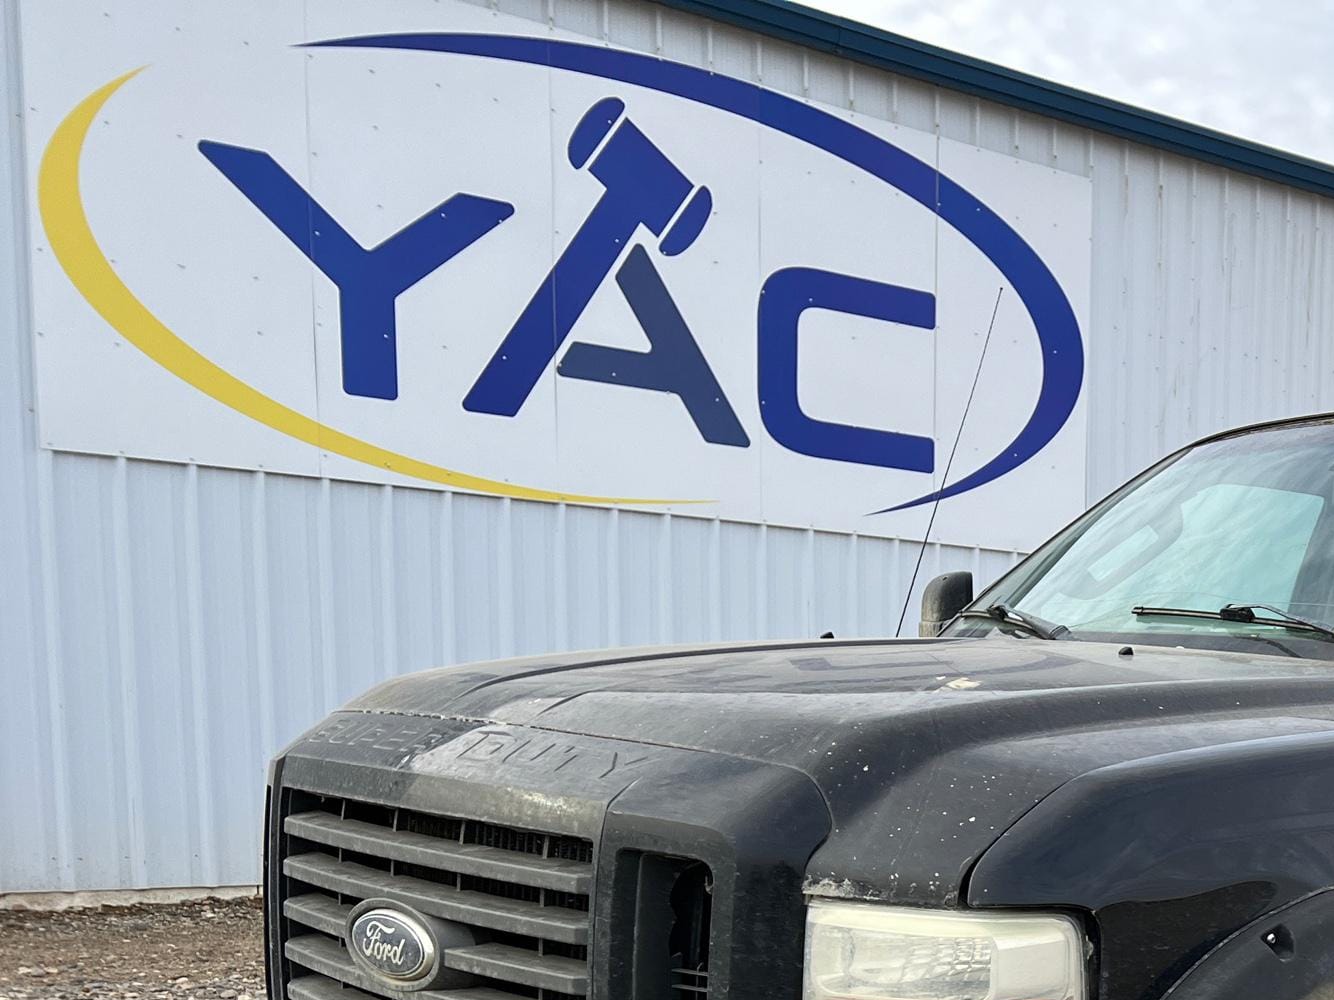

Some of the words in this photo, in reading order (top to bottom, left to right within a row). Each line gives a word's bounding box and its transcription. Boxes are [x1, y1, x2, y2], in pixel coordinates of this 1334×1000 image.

[197, 96, 936, 474] YAC
[308, 718, 445, 755] SUPER
[456, 729, 649, 779] DUTY
[362, 920, 406, 966] Ford
